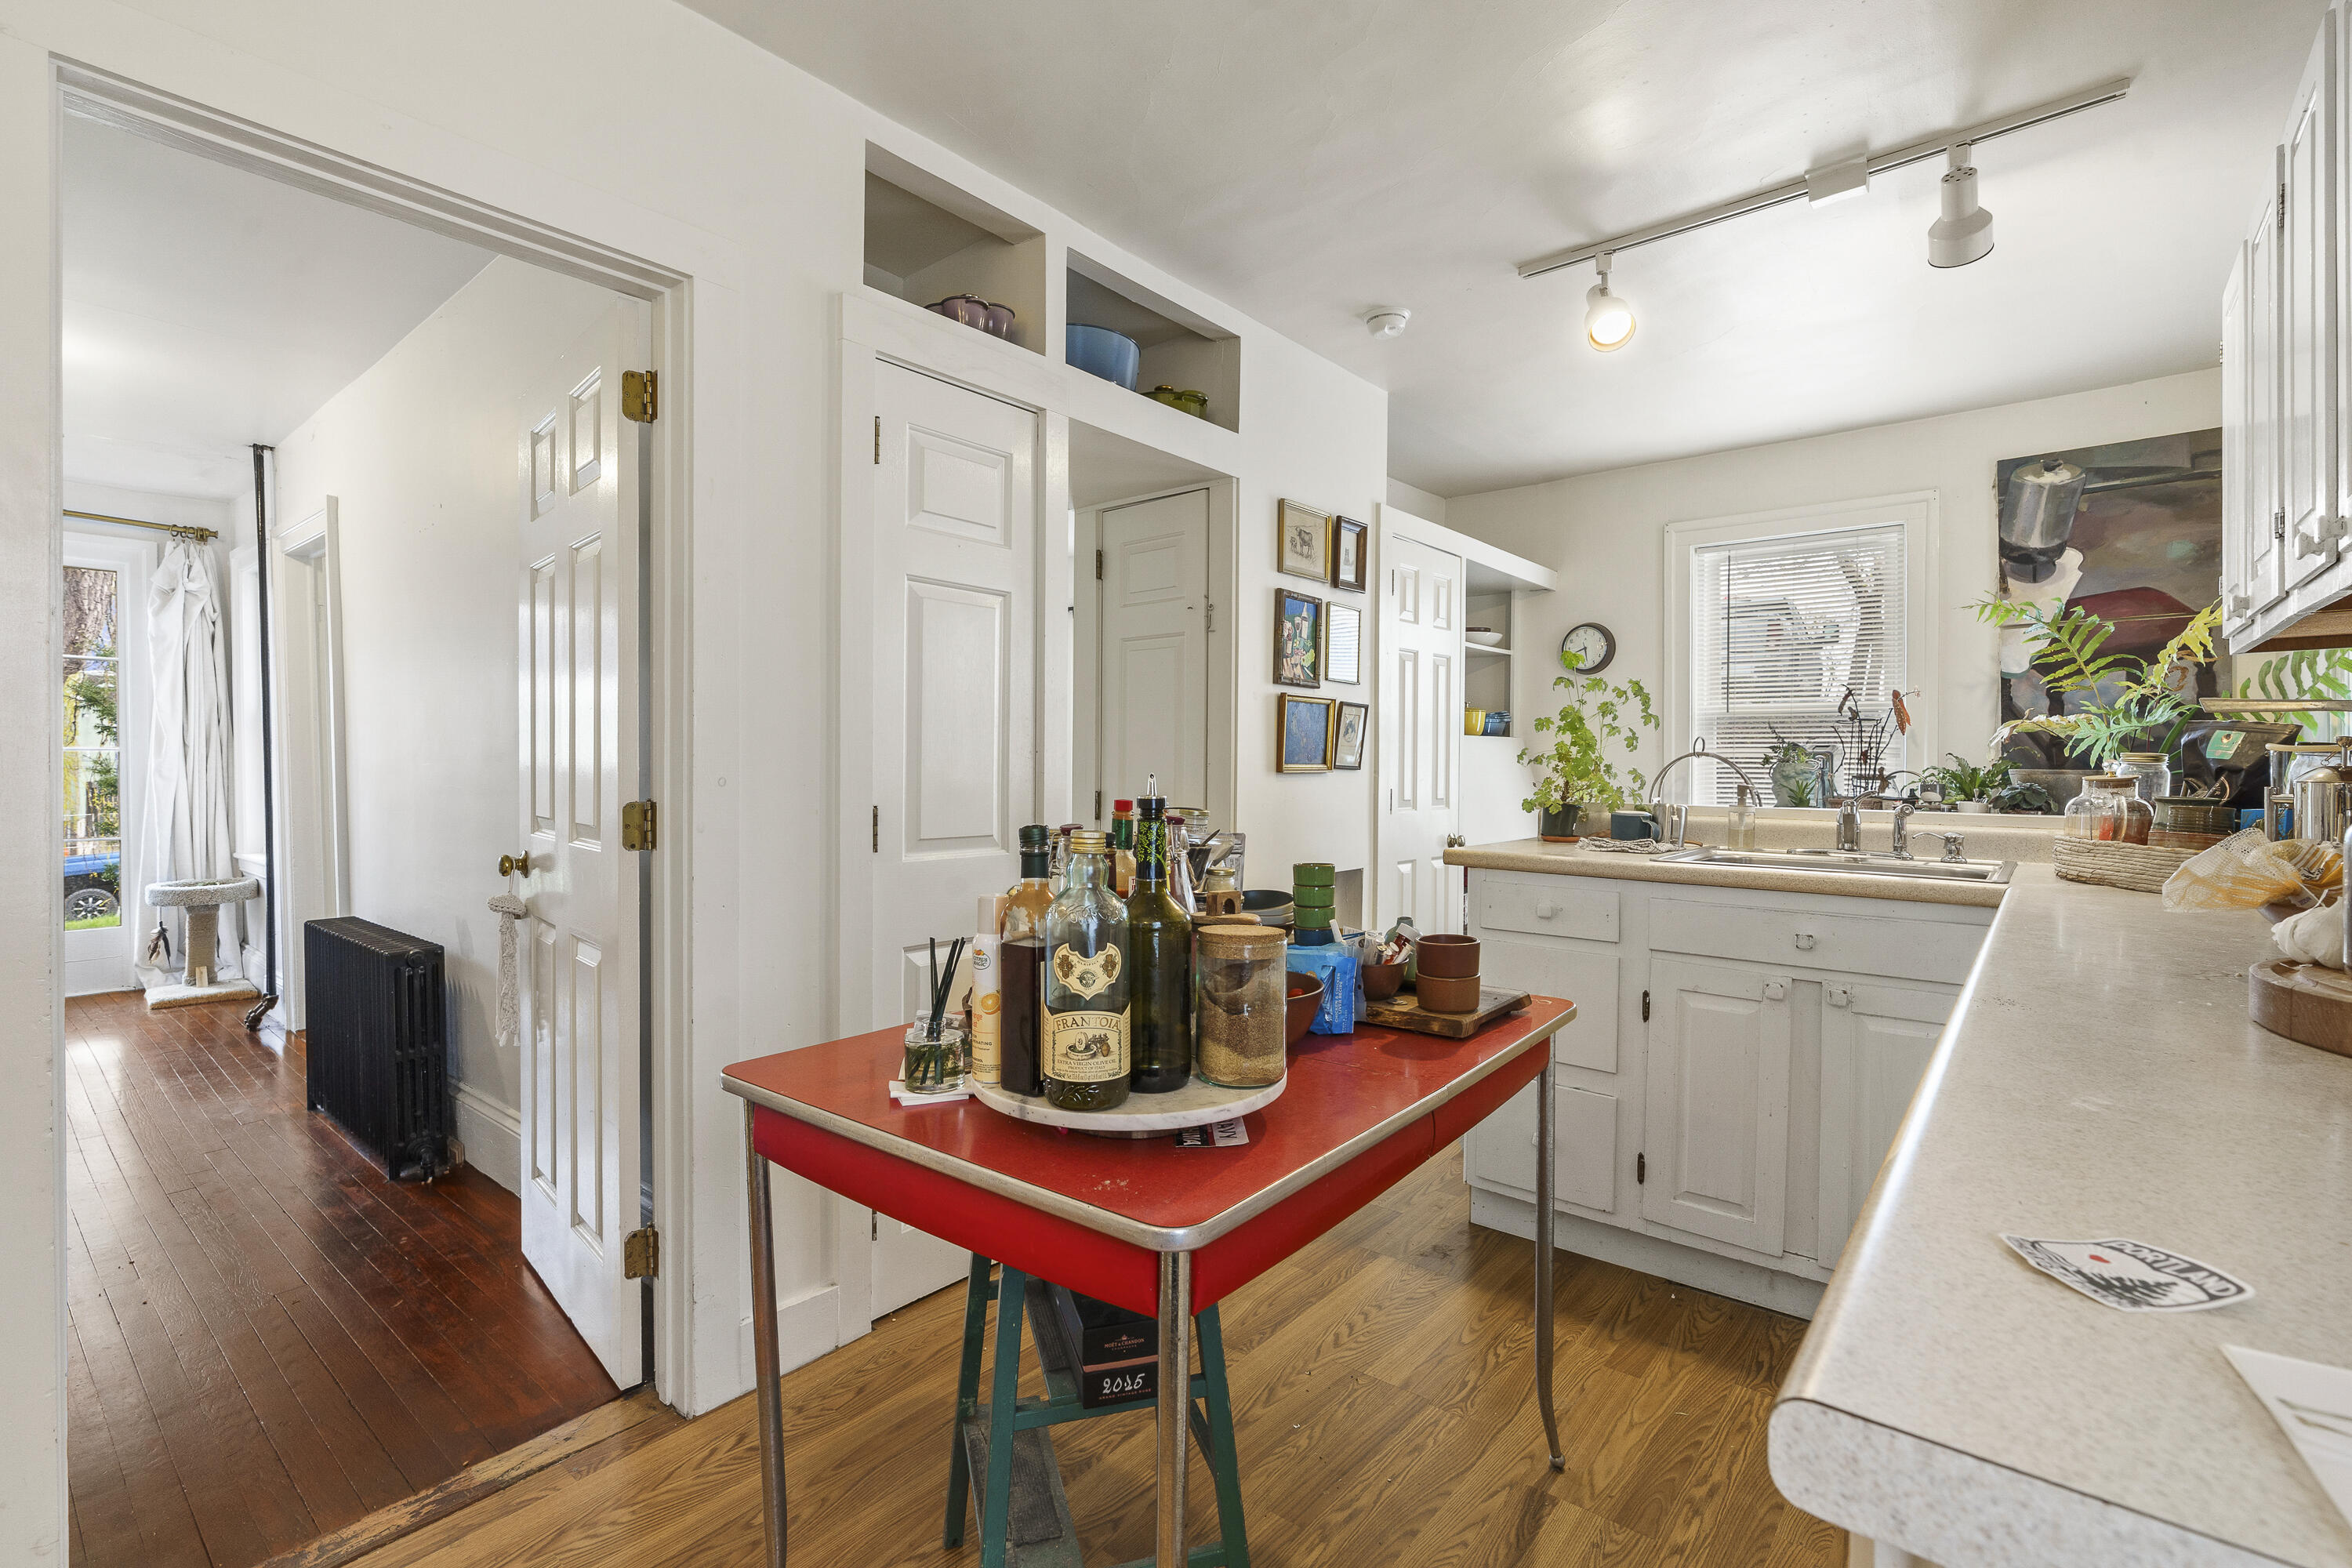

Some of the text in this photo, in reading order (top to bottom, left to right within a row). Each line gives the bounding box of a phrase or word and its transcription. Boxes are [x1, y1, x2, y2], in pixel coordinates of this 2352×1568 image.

[1055, 1017, 1120, 1030] FRANTOIA
[2103, 1240, 2238, 1297] PORTLAND
[1121, 1338, 1145, 1346] CHANDON
[1102, 1373, 1145, 1394] 2015
